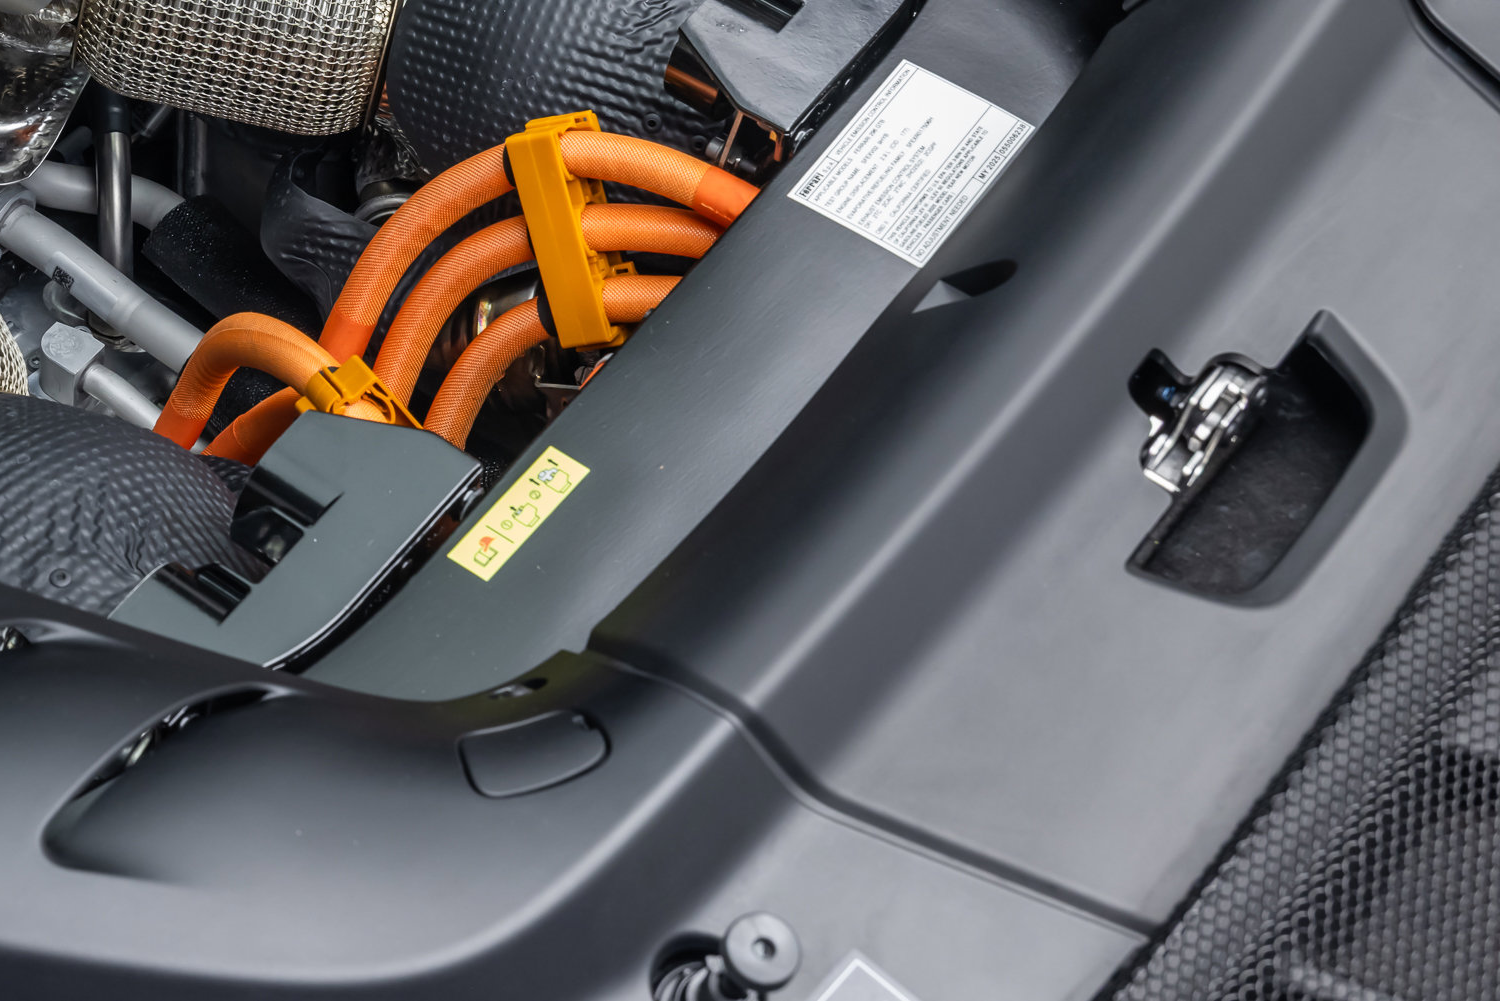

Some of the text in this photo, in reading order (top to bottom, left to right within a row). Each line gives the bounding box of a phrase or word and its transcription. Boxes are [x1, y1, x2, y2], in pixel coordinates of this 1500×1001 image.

[834, 68, 911, 155] VEHICLE EMISSION CONTROL INFORMATION
[798, 171, 824, 197] Ferrari
[812, 175, 837, 202] APPLICABLE
[852, 135, 871, 154] FERRARI
[856, 145, 926, 225] EXHAUST EMISSION CONTROL SYSTEM
[886, 231, 897, 241] THIS
[894, 214, 910, 232] VEHICLE
[907, 192, 928, 215] CONFORMS
[937, 170, 946, 179] EPA
[963, 137, 974, 146] AND
[970, 125, 983, 138] STATE
[897, 214, 919, 238] CALIFORNIA
[940, 158, 965, 185] REGULATIONS
[962, 135, 983, 159] APPLICABLE
[934, 189, 948, 204] MODEL
[954, 169, 964, 179] NEW
[961, 154, 976, 170] MOTOR
[977, 154, 1001, 179] MY 2025
[823, 195, 836, 207] TEST
[833, 179, 850, 196] GROUP
[834, 196, 852, 213] ENGINE
[888, 191, 913, 218] CALIFORNIA
[909, 168, 931, 192] CERTIFIED
[904, 231, 923, 251] VEHICLES
[914, 194, 969, 258] NO ADJUSTMENT NEEDED
